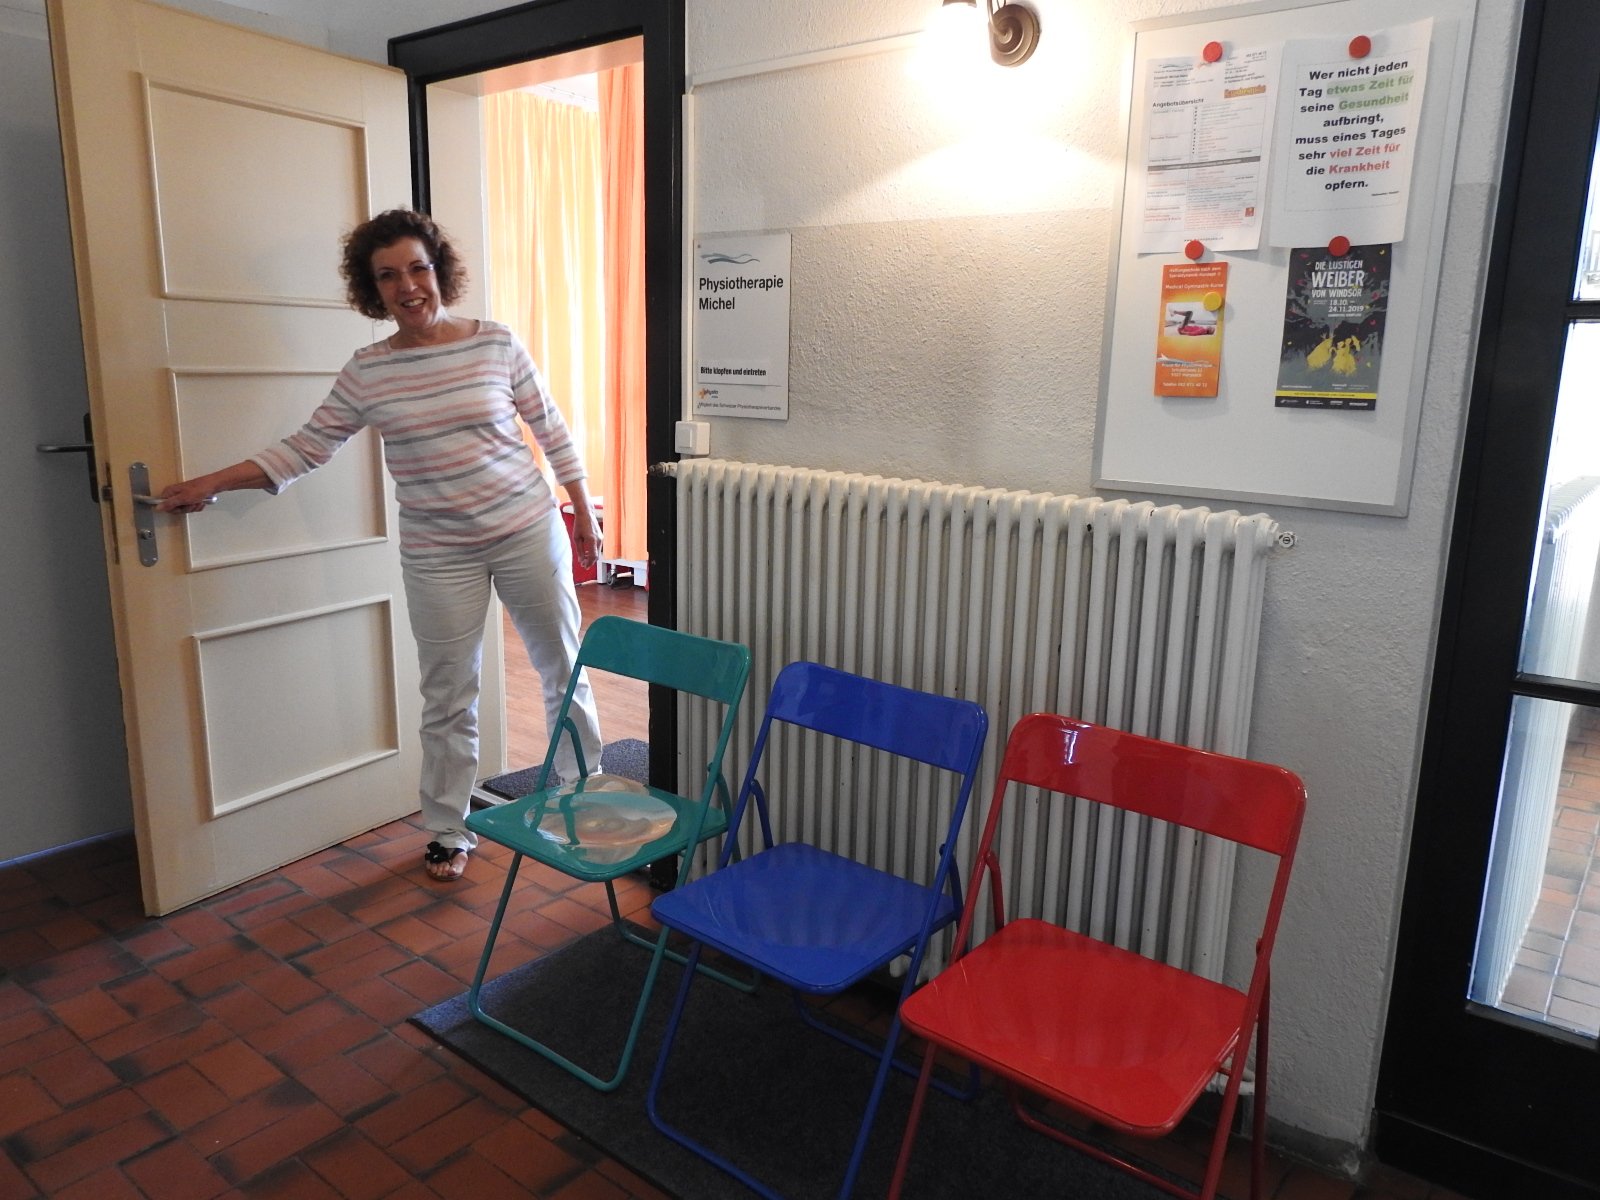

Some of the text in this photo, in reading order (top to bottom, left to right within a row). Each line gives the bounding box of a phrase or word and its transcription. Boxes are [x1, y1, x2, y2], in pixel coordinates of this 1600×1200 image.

[1309, 61, 1408, 80] Wer nicht jeden
[1299, 74, 1414, 98] Tag etwas Zeit für
[1300, 92, 1409, 112] seine Gesundheit
[1323, 113, 1384, 128] aufbringt,
[1295, 127, 1406, 144] muss eines Tages
[1298, 143, 1400, 160] sehr viel Zeit für
[1306, 160, 1390, 175] die Krankheit
[1324, 180, 1368, 192] opfern.
[1315, 260, 1364, 270] DIE LUSTIGEN
[699, 275, 784, 293] Physiotherapie
[1312, 270, 1365, 288] WEIBER
[1312, 289, 1362, 298] VON WINDSOR
[699, 297, 735, 310] Michel
[700, 366, 712, 374] Bitte
[714, 367, 732, 376] klopfen
